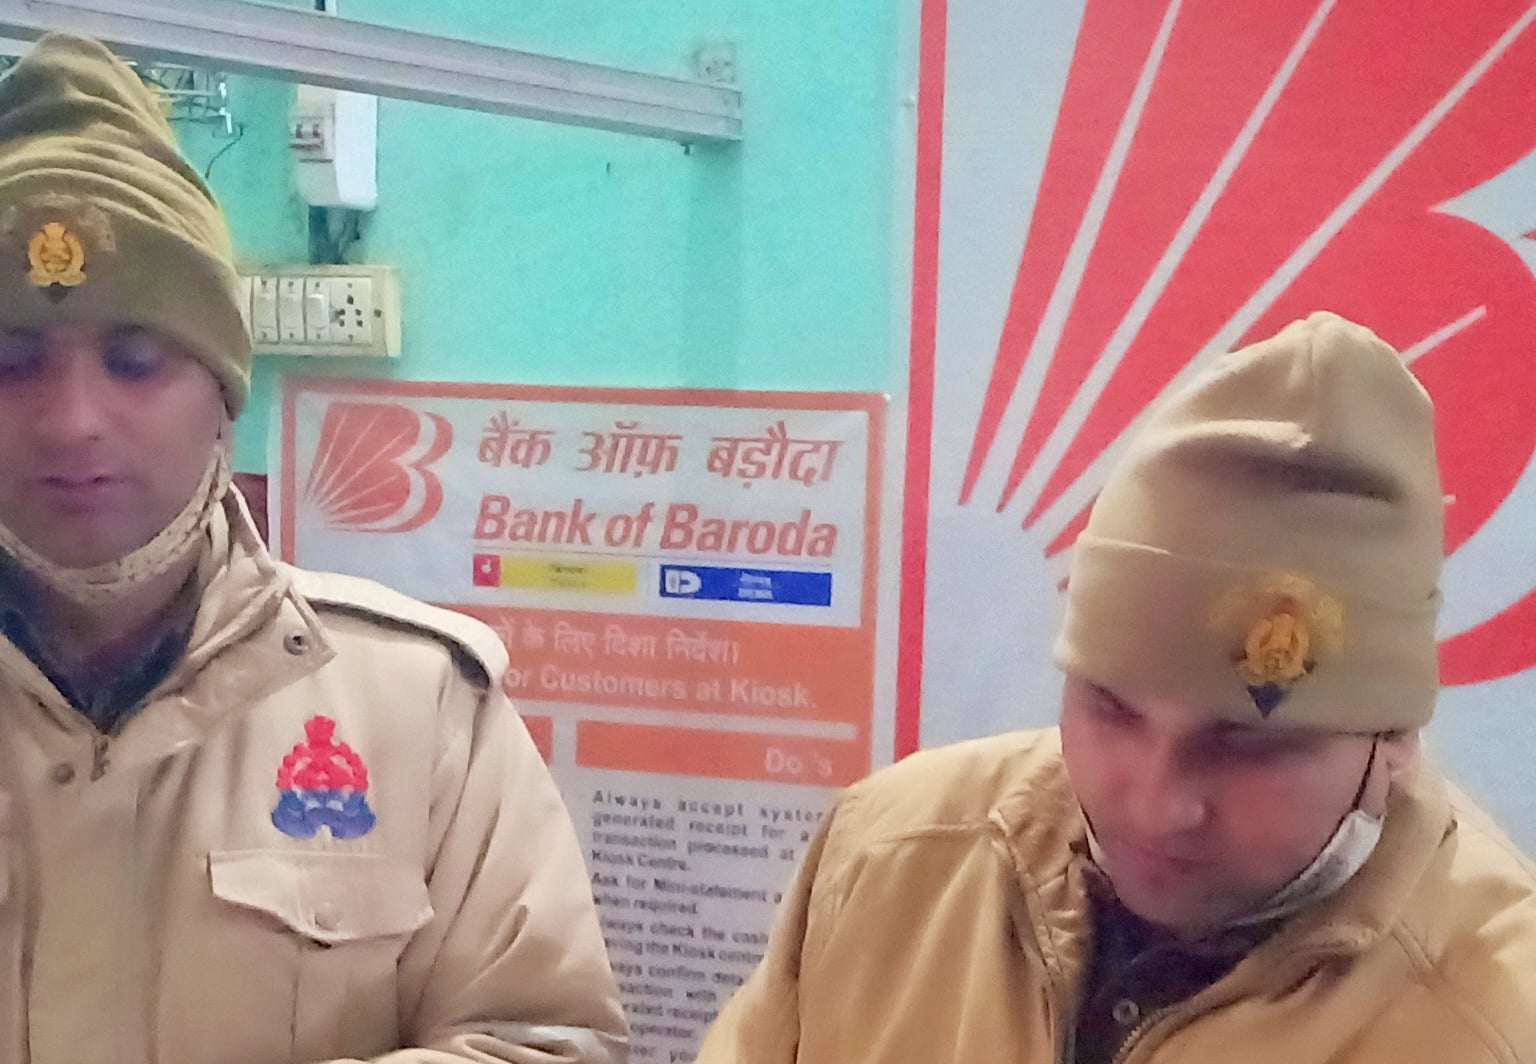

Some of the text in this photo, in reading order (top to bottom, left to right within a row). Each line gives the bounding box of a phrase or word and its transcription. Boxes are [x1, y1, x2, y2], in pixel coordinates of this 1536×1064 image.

[477, 410, 556, 469] बैंक
[707, 420, 845, 489] बड़ौदा
[473, 494, 839, 558] Bank of Baroda
[505, 667, 530, 688] or
[540, 664, 688, 700] Customers
[695, 679, 721, 700] at
[592, 789, 662, 811] Always
[678, 800, 745, 818] accept
